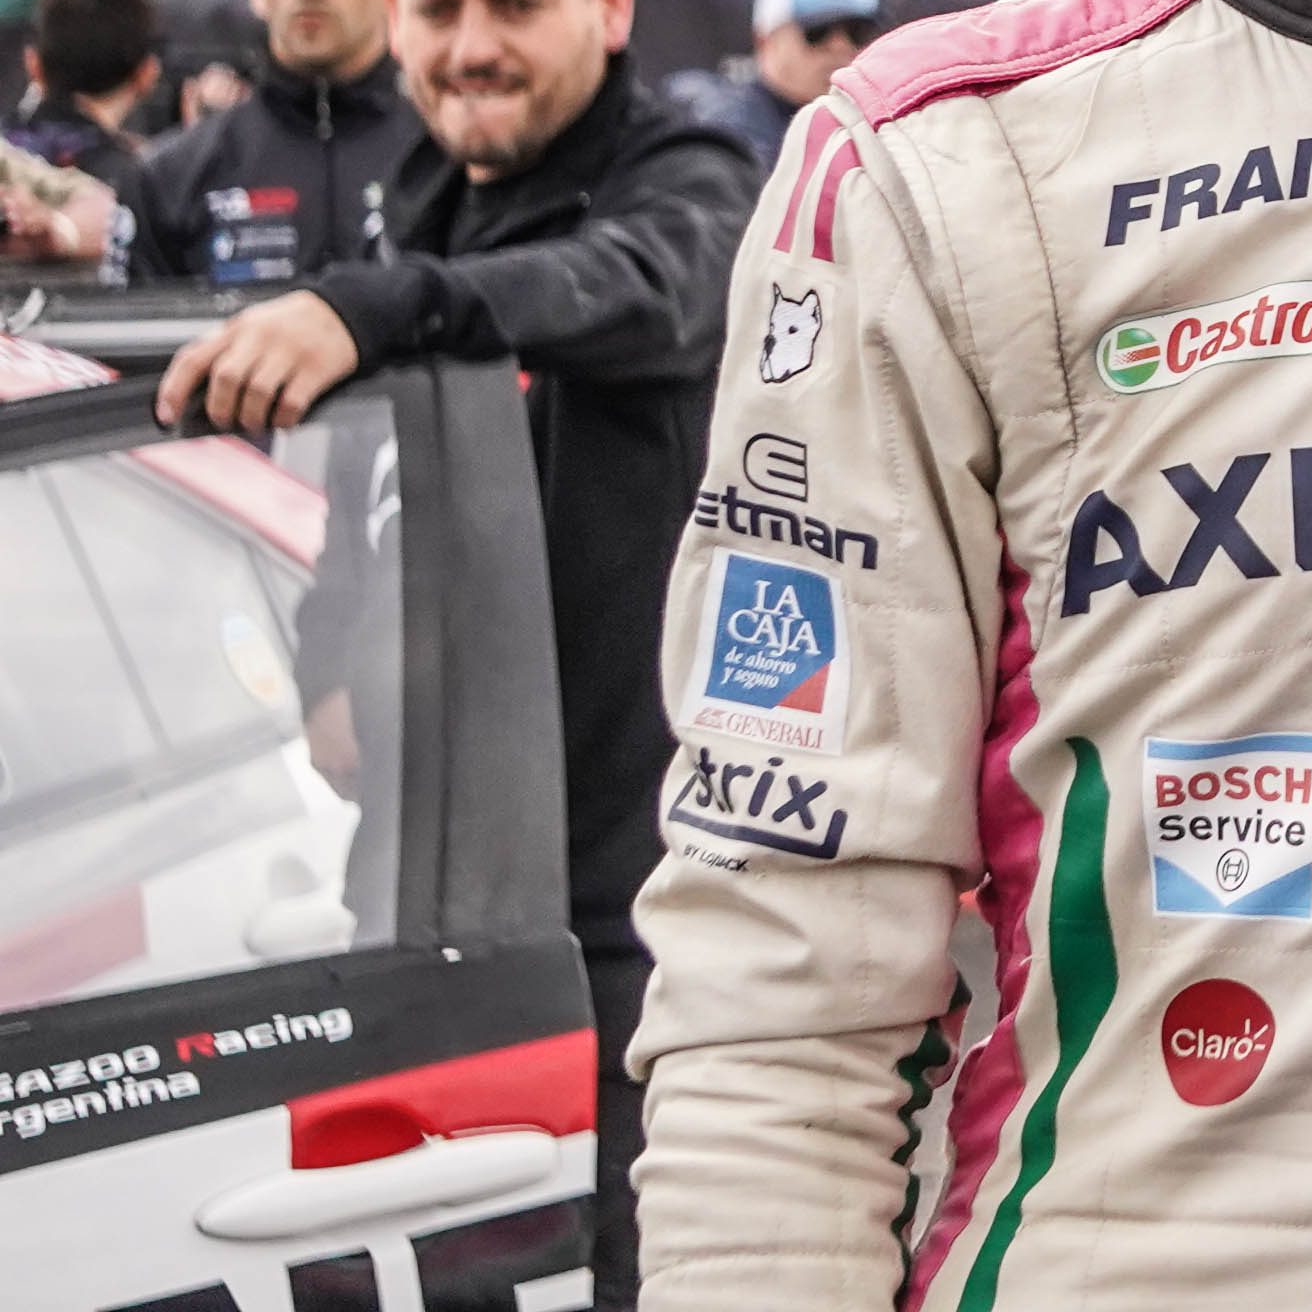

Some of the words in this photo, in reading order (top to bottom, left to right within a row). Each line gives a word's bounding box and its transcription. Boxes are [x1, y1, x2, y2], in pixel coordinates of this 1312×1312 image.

[752, 579, 804, 619] LA
[727, 608, 822, 657] CAJA
[720, 666, 734, 685] y
[734, 669, 780, 690] seguro
[724, 645, 742, 664] de
[744, 650, 797, 675] ahorro
[726, 711, 824, 750] GENERALI
[1156, 765, 1312, 809] BOSCH
[175, 1006, 354, 1063] Racing
[1171, 1022, 1258, 1061] Claro
